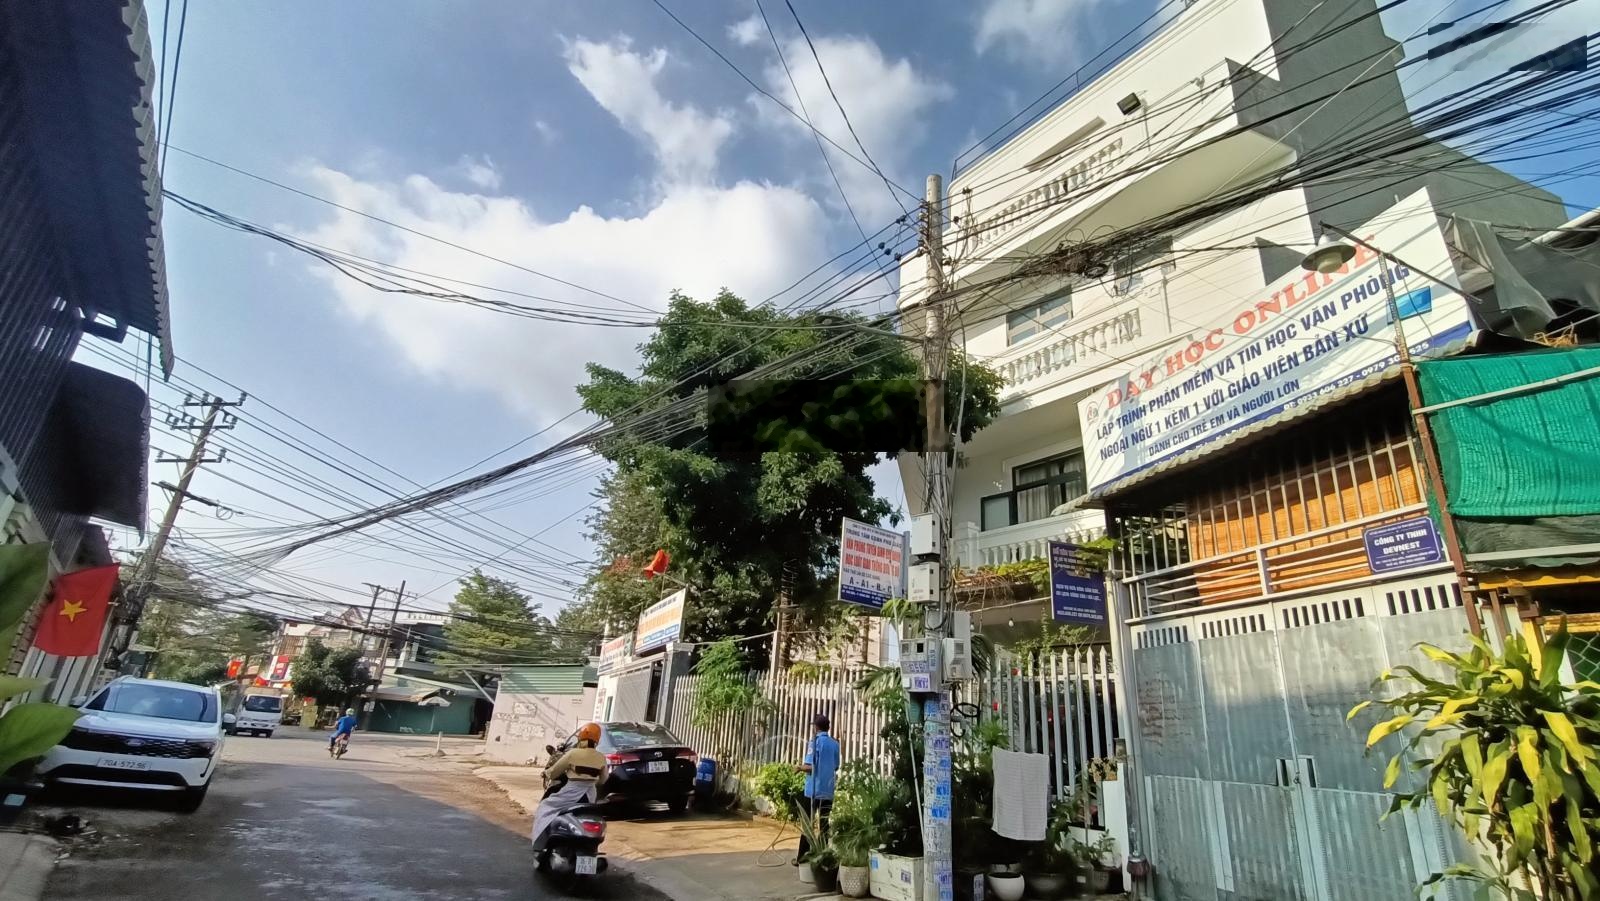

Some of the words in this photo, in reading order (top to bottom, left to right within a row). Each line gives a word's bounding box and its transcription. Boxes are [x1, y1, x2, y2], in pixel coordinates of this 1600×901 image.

[1097, 422, 1114, 440] LẬP
[1116, 405, 1147, 429] TRÌNH
[1149, 386, 1180, 412] PHẦN
[1183, 368, 1214, 395] MỀM
[1217, 355, 1235, 376] VÀ
[1237, 342, 1262, 365] TIN
[1266, 323, 1297, 350] HỌC
[1301, 301, 1337, 331] VĂN
[1341, 264, 1410, 310] PHÒNG
[1101, 436, 1129, 460] NGOẠI
[1131, 422, 1153, 446] NGỮ
[1155, 420, 1161, 433] 1
[1164, 406, 1190, 429] KÈM
[1193, 401, 1200, 416] 1
[1203, 388, 1225, 410] VỚI
[1228, 371, 1260, 398] GIÁO
[1263, 352, 1299, 380] VIÊN
[1303, 331, 1339, 362] BẢN
[1343, 313, 1369, 342] XỨ
[1107, 365, 1157, 410] DẠY
[1165, 328, 1224, 377] HỌC
[1172, 430, 1190, 445] CHO
[1191, 419, 1208, 436] TRẺ
[1210, 414, 1225, 428] EM
[1227, 405, 1240, 420] VÀ
[1242, 390, 1275, 414] NGƯỜI
[1277, 379, 1300, 398] LỚN
[1374, 534, 1394, 546] CÔNG
[1396, 533, 1405, 541] TY
[1406, 528, 1427, 539] TNHH
